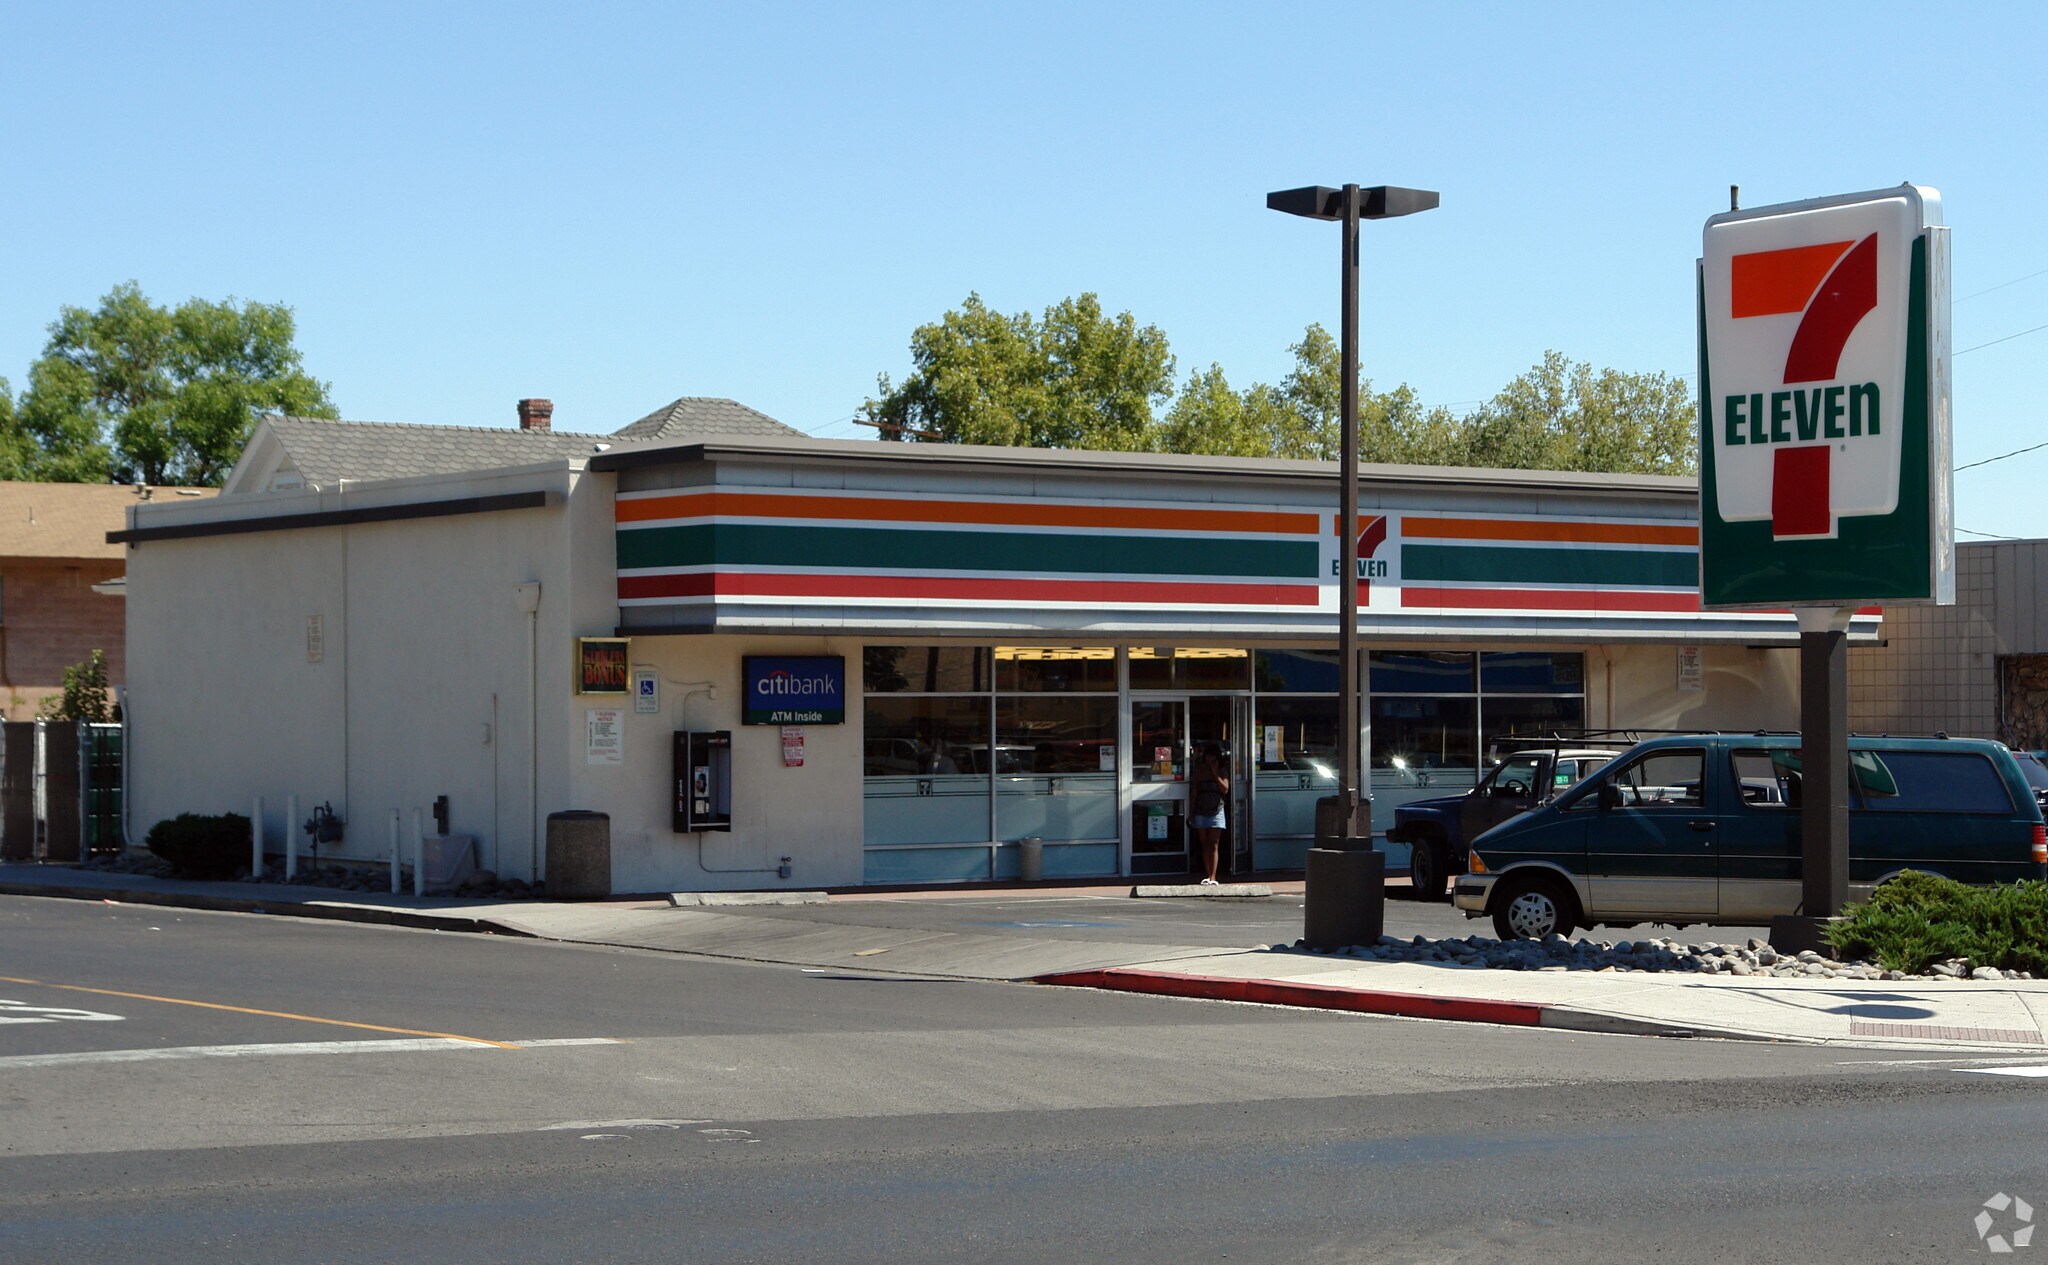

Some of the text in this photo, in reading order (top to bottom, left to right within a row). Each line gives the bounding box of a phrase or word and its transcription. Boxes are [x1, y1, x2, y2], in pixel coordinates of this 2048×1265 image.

[1332, 559, 1387, 577] EVEn
[1334, 515, 1387, 607] 7
[584, 663, 625, 685] BONUS
[757, 673, 835, 695] citibank
[770, 711, 823, 722] ATM Inside
